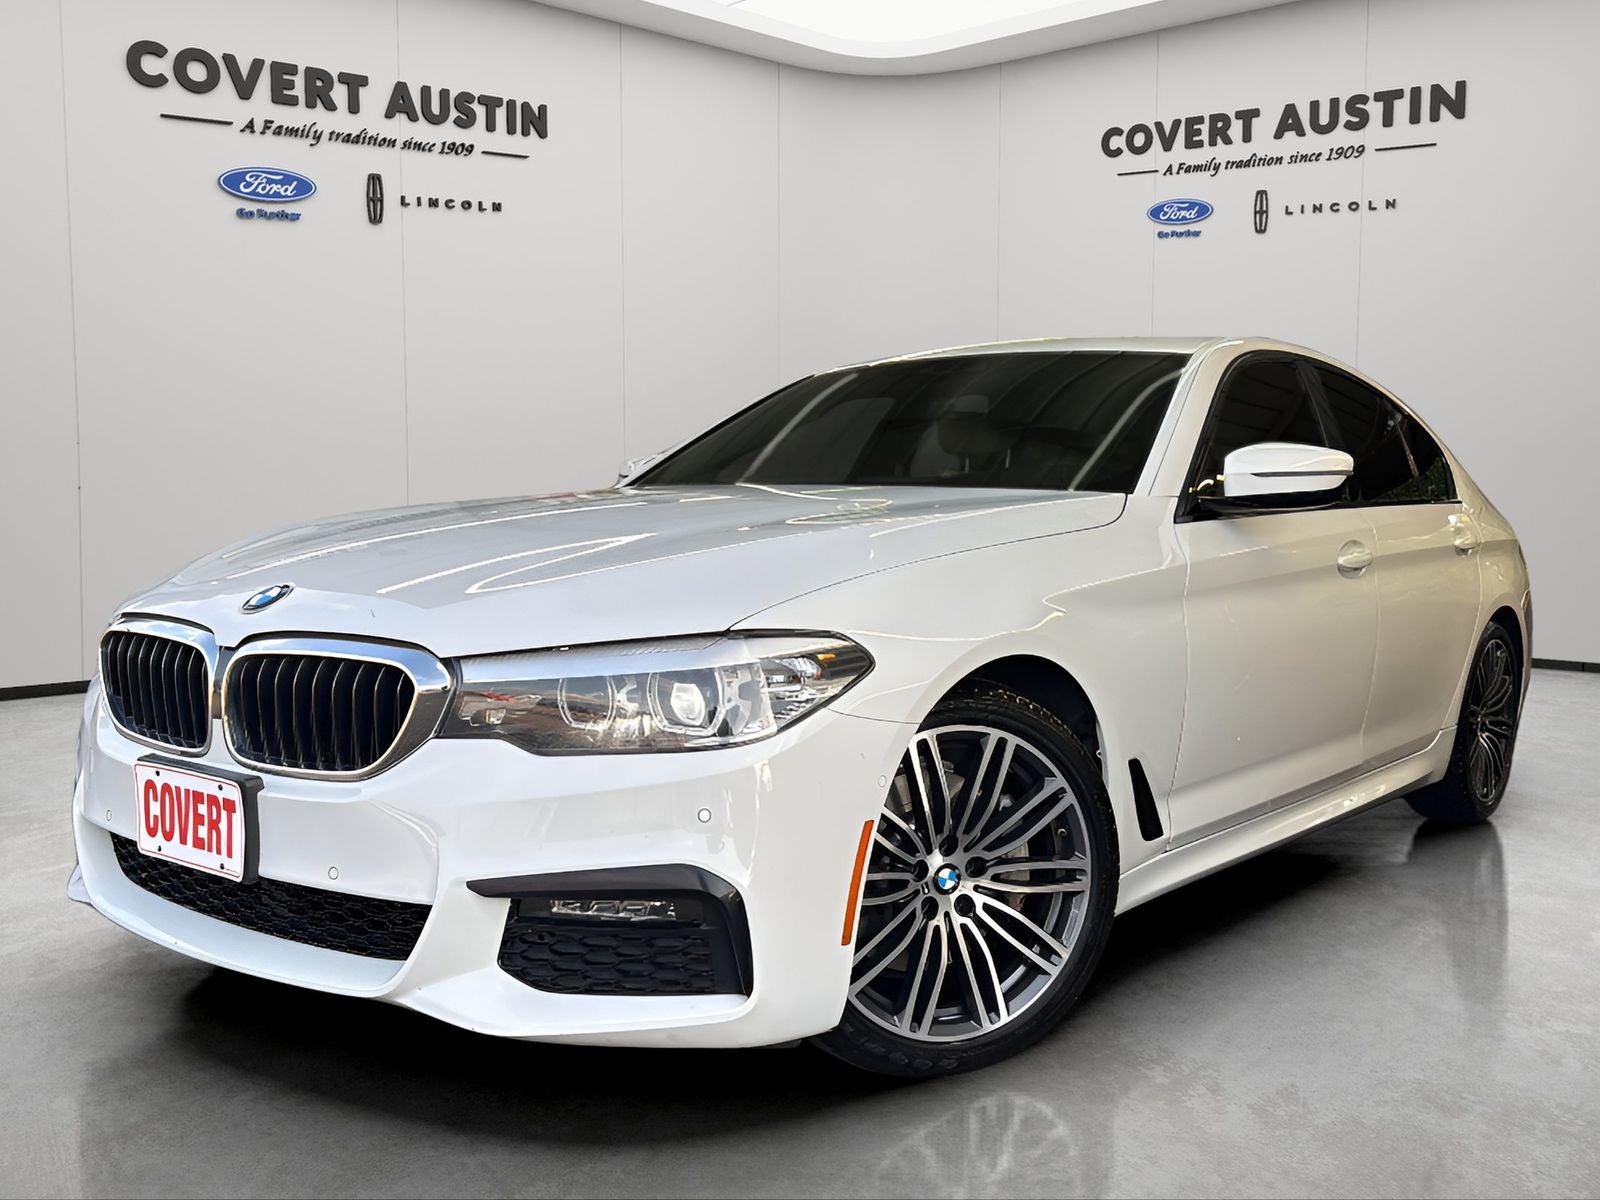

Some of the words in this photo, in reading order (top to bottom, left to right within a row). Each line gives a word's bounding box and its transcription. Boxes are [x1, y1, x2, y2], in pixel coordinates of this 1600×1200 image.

[126, 40, 368, 114] COVERT
[384, 81, 548, 139] AUSTIN
[1100, 108, 1260, 158] COVERT
[1273, 80, 1467, 140] AUSTIN
[239, 117, 256, 134] A
[260, 119, 324, 147] Family
[328, 128, 397, 149] tradition
[400, 137, 437, 153] since
[438, 141, 475, 157] 1909
[1163, 163, 1173, 176] A
[1176, 157, 1221, 177] Family
[1225, 153, 1284, 170] tradition
[1287, 151, 1323, 165] since
[1326, 144, 1366, 161] 1909
[240, 171, 298, 197] Ford
[236, 207, 255, 219] Go
[400, 195, 502, 213] LINCOLN
[1160, 203, 1199, 220] Ford
[1285, 198, 1397, 216] LINCOLN
[1157, 230, 1170, 239] Go
[144, 779, 236, 858] COVERT
